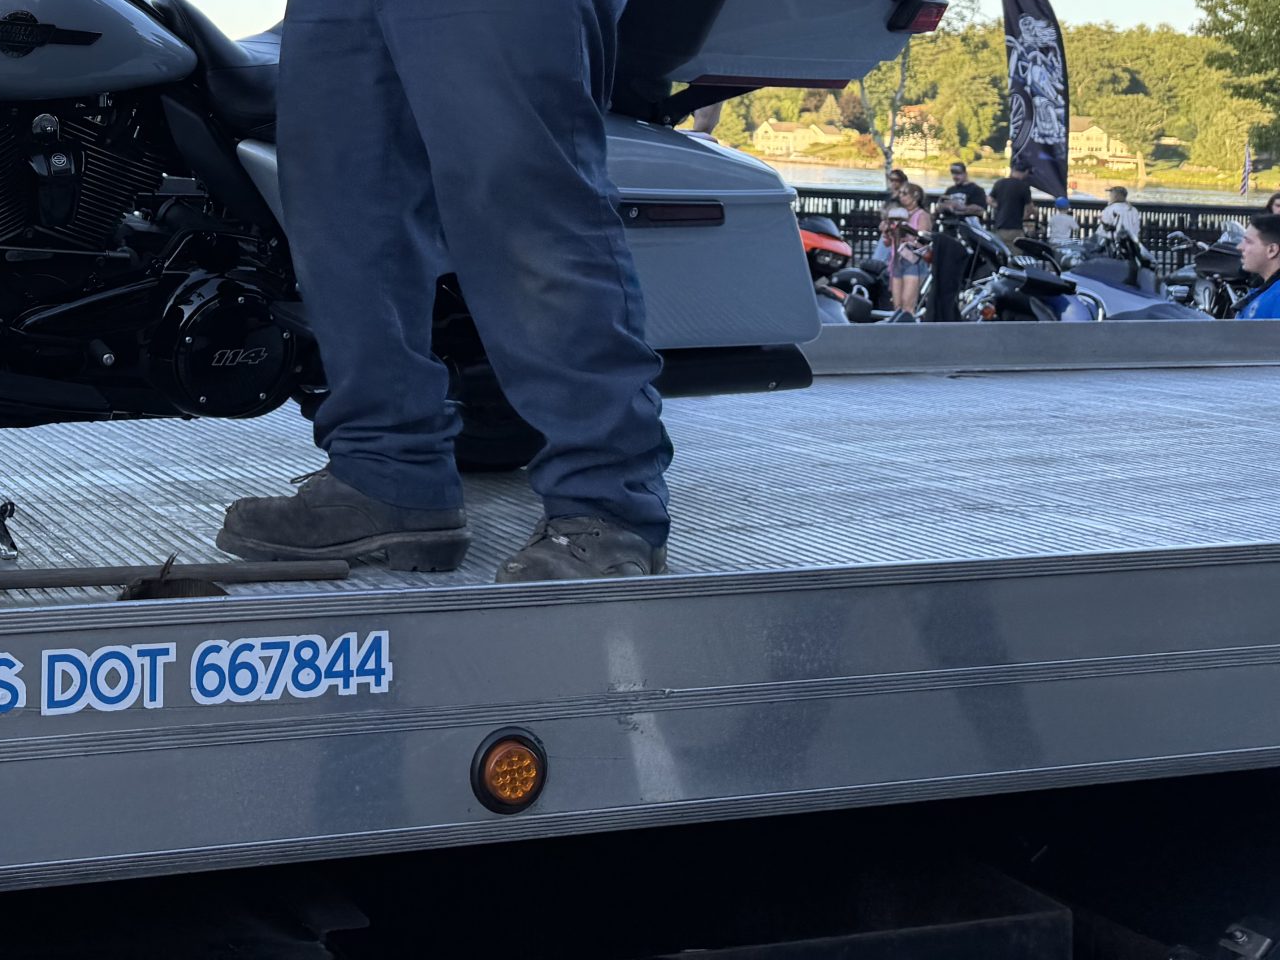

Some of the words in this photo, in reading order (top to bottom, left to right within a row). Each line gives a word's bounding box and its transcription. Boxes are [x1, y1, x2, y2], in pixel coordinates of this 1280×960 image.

[211, 347, 269, 366] 114
[44, 645, 173, 711] DOT
[193, 633, 389, 700] 667844
